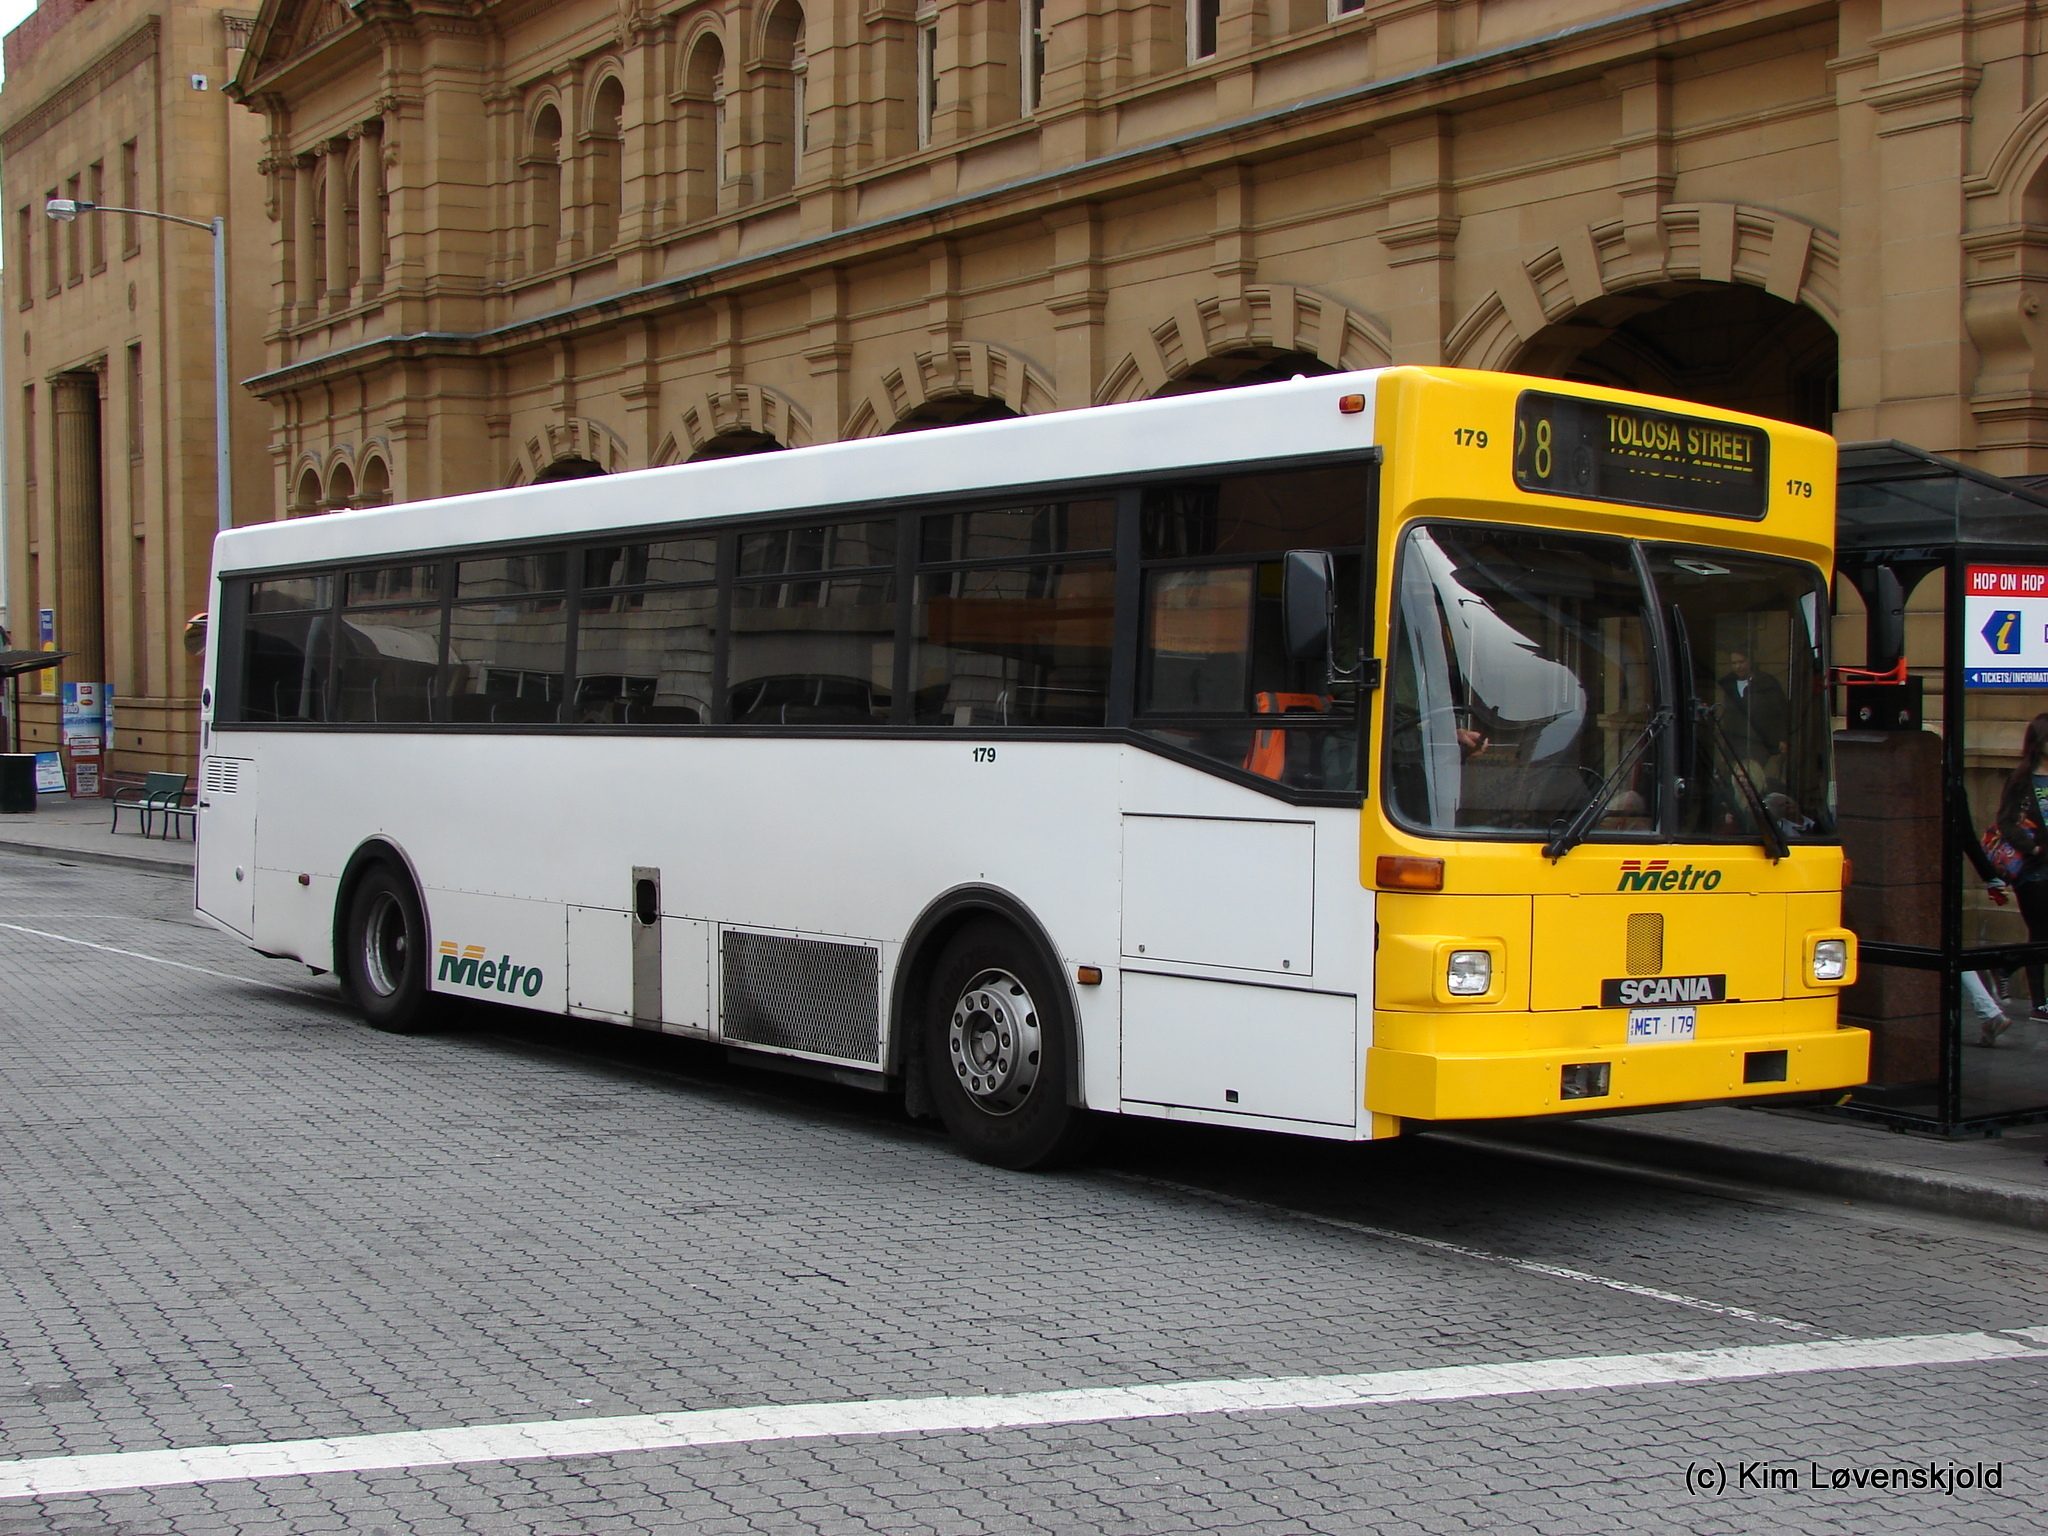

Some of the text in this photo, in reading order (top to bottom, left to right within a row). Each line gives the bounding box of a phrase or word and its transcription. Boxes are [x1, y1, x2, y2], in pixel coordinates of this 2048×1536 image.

[1453, 427, 1489, 449] 179
[1606, 414, 1681, 452] TOLOSA
[1687, 426, 1754, 463] STREET
[1785, 479, 1813, 499] 179
[1973, 572, 2045, 592] HOP ON HOP
[972, 747, 996, 763] 179
[1616, 860, 1721, 891] Metro
[437, 940, 543, 997] Metro
[1619, 977, 1713, 1004] SCANIA
[1634, 1015, 1694, 1036] MET 179
